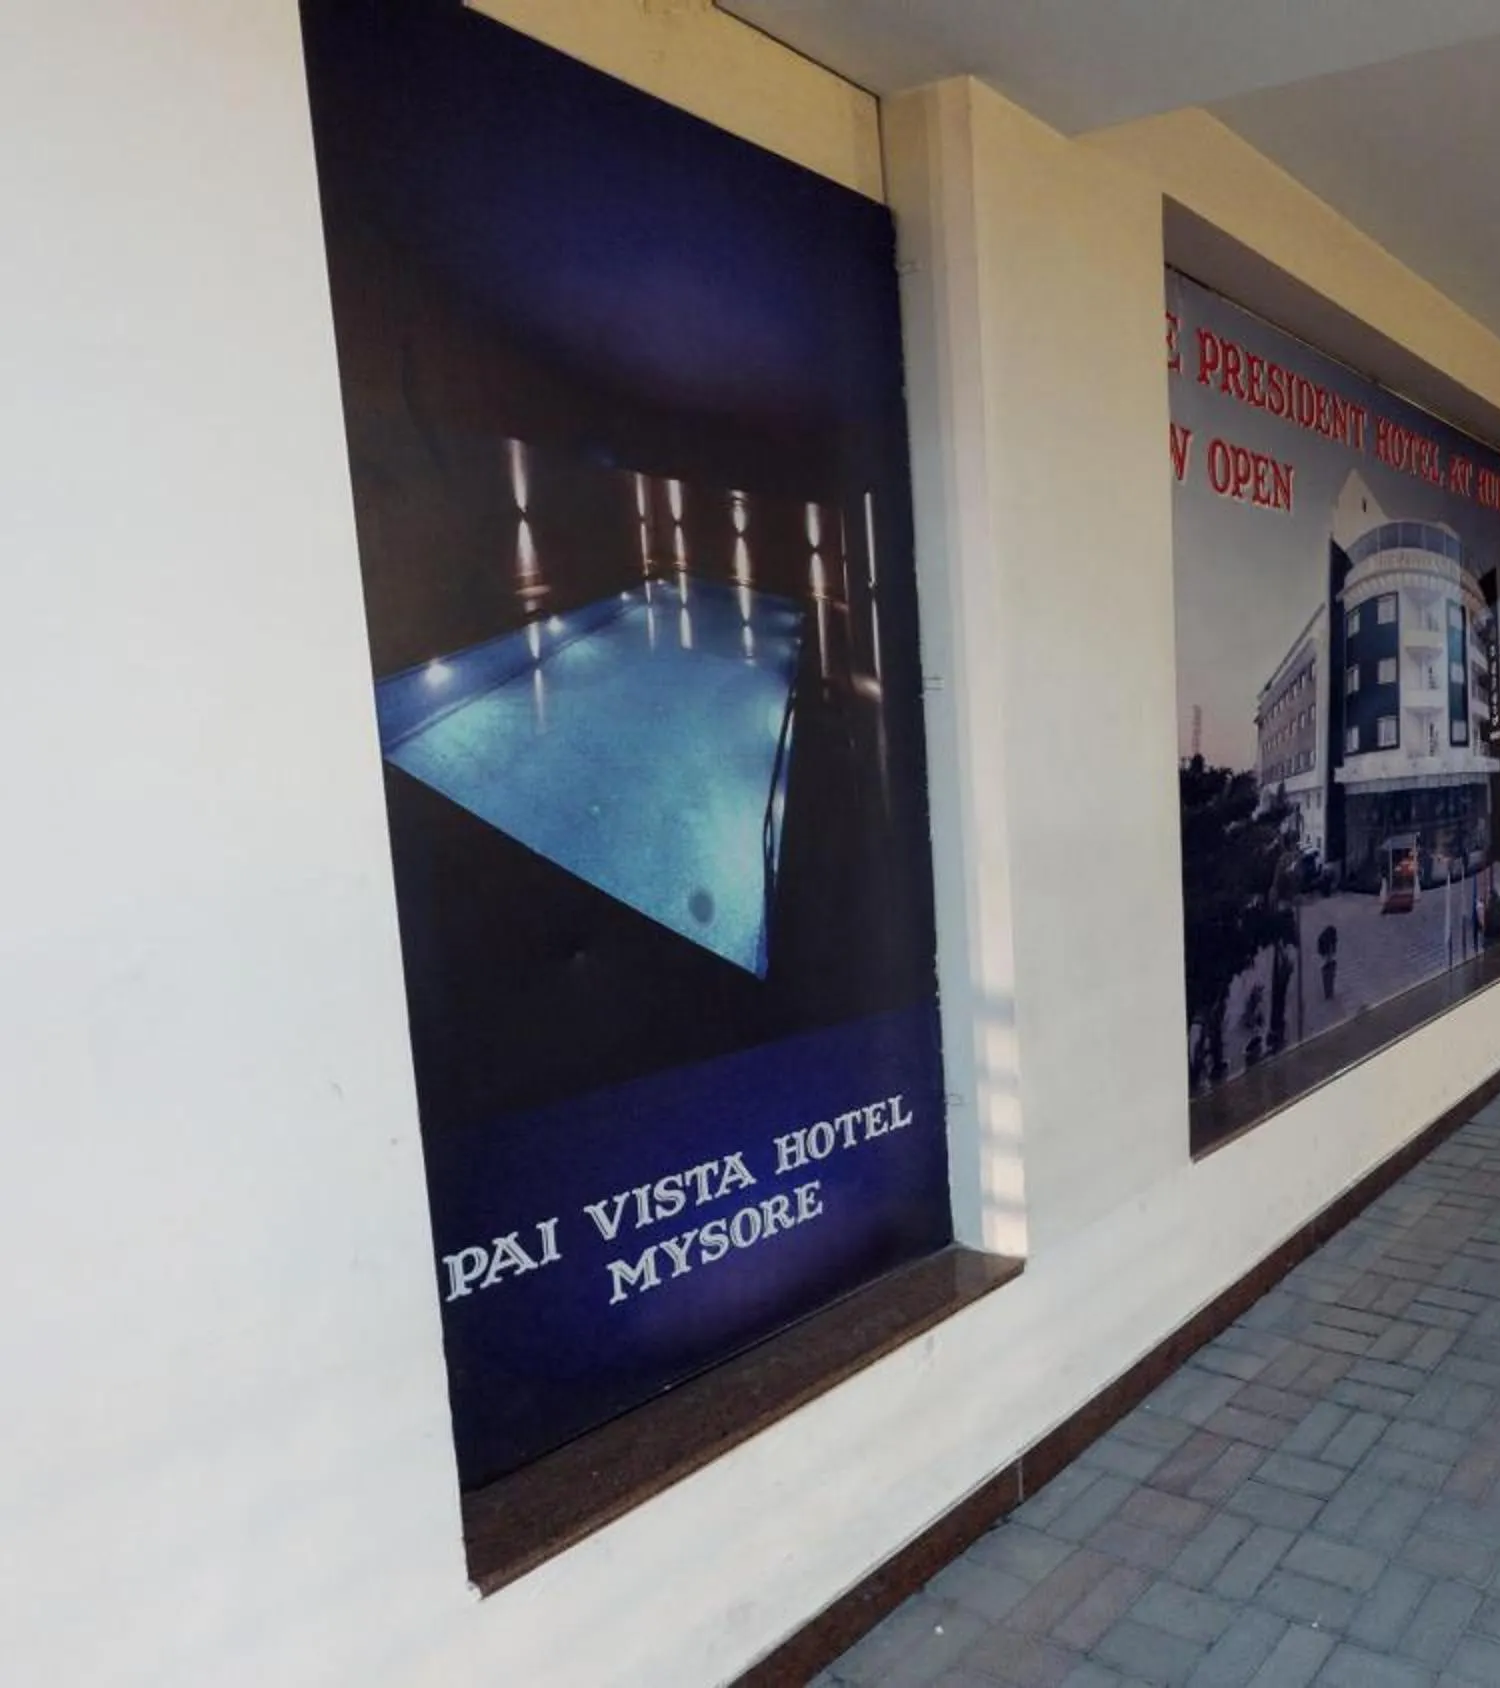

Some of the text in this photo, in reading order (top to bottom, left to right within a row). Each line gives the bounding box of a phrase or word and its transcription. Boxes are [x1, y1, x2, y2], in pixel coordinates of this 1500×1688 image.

[1196, 326, 1367, 453] PRESIDENT
[1207, 437, 1294, 513] OPEN
[442, 1094, 913, 1302] PAI VISTA HOTEL
[606, 1180, 824, 1306] MYSORE
